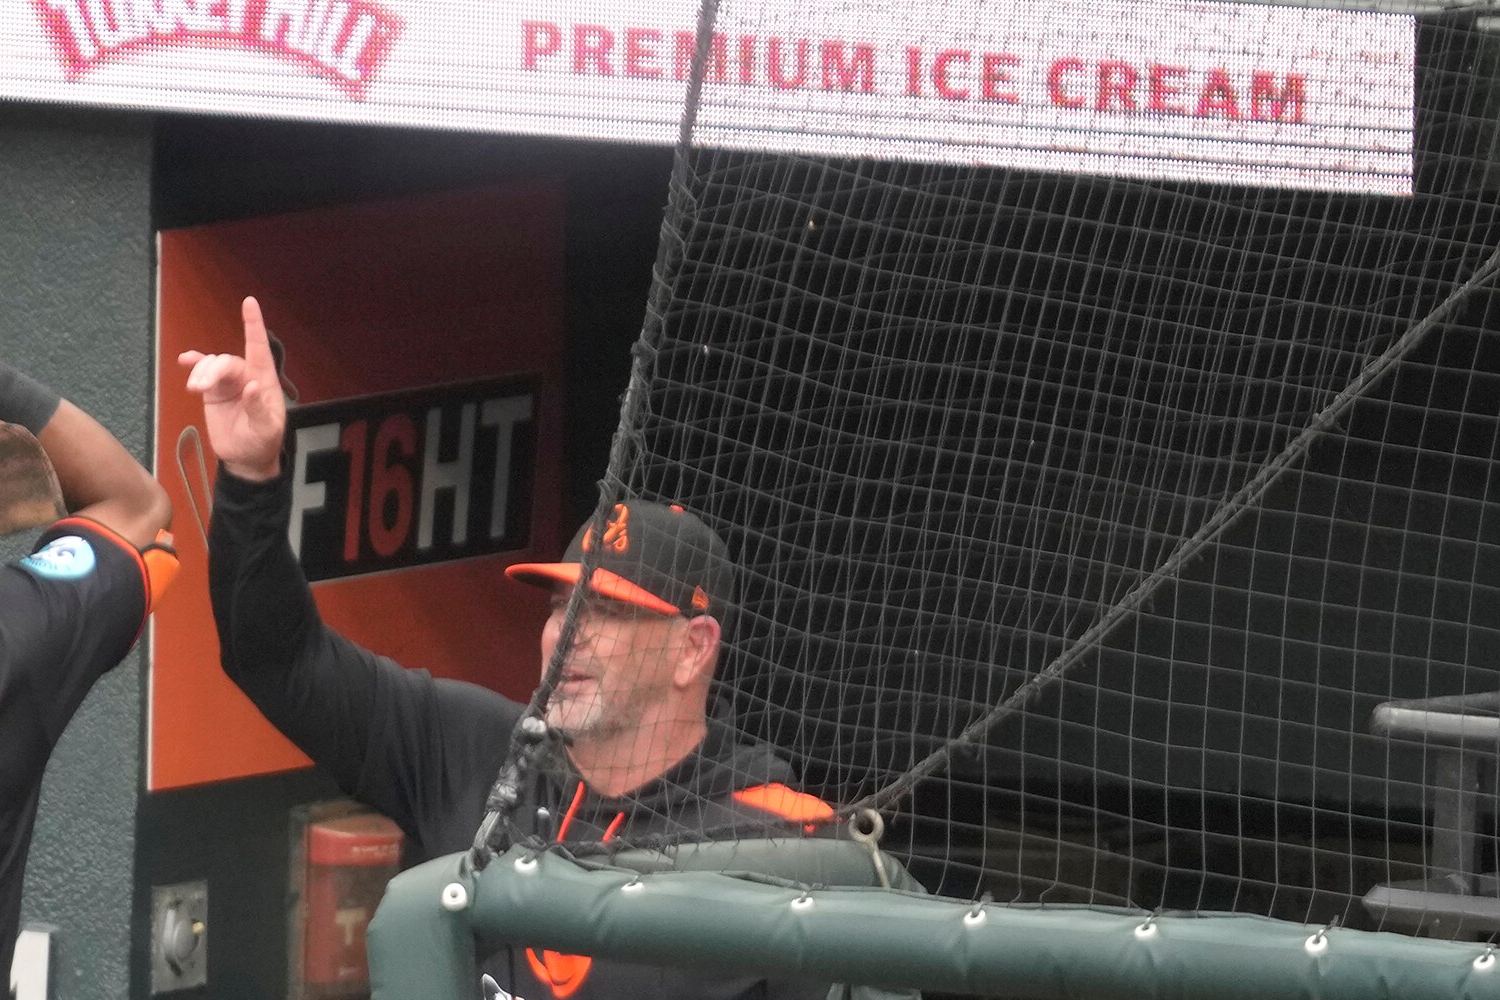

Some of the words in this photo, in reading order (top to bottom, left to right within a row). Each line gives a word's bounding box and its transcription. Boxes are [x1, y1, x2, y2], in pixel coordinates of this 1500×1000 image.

[521, 20, 875, 93] PREMIUM
[905, 45, 1021, 102] ICE
[1047, 56, 1307, 123] CREAM
